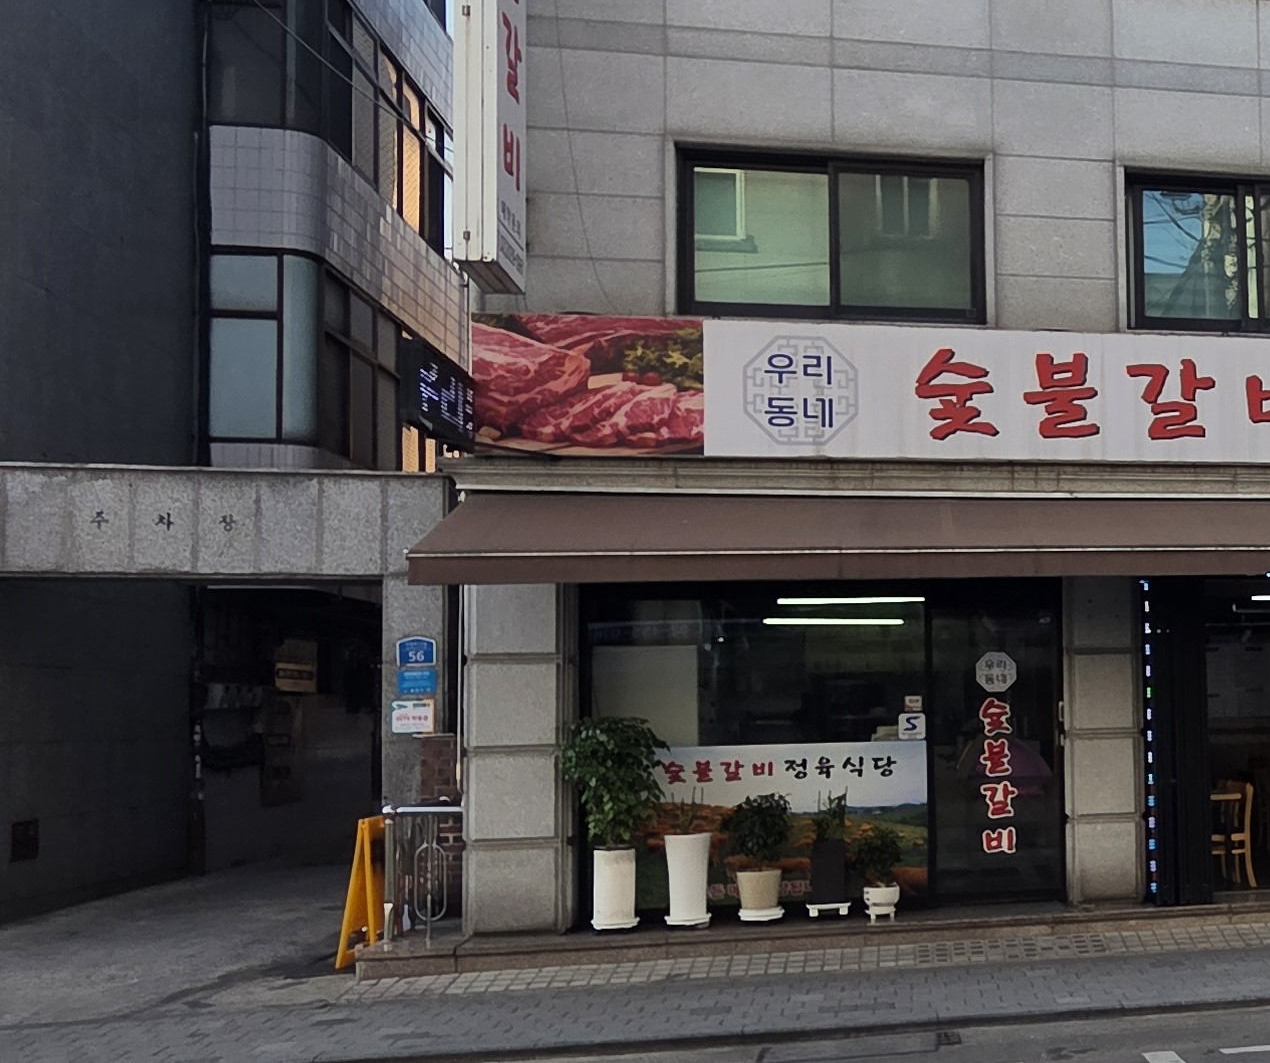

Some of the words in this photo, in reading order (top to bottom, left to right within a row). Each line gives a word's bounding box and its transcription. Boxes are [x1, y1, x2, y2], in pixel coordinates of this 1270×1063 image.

[763, 353, 834, 387] 우리
[763, 394, 836, 430] 동네
[90, 511, 236, 532] 주차장
[408, 650, 425, 662] 56
[984, 658, 1007, 671] 우리
[661, 760, 774, 785] 숯불갈비
[784, 755, 897, 779] 정육식당
[979, 698, 1018, 852] 숯불갈비
